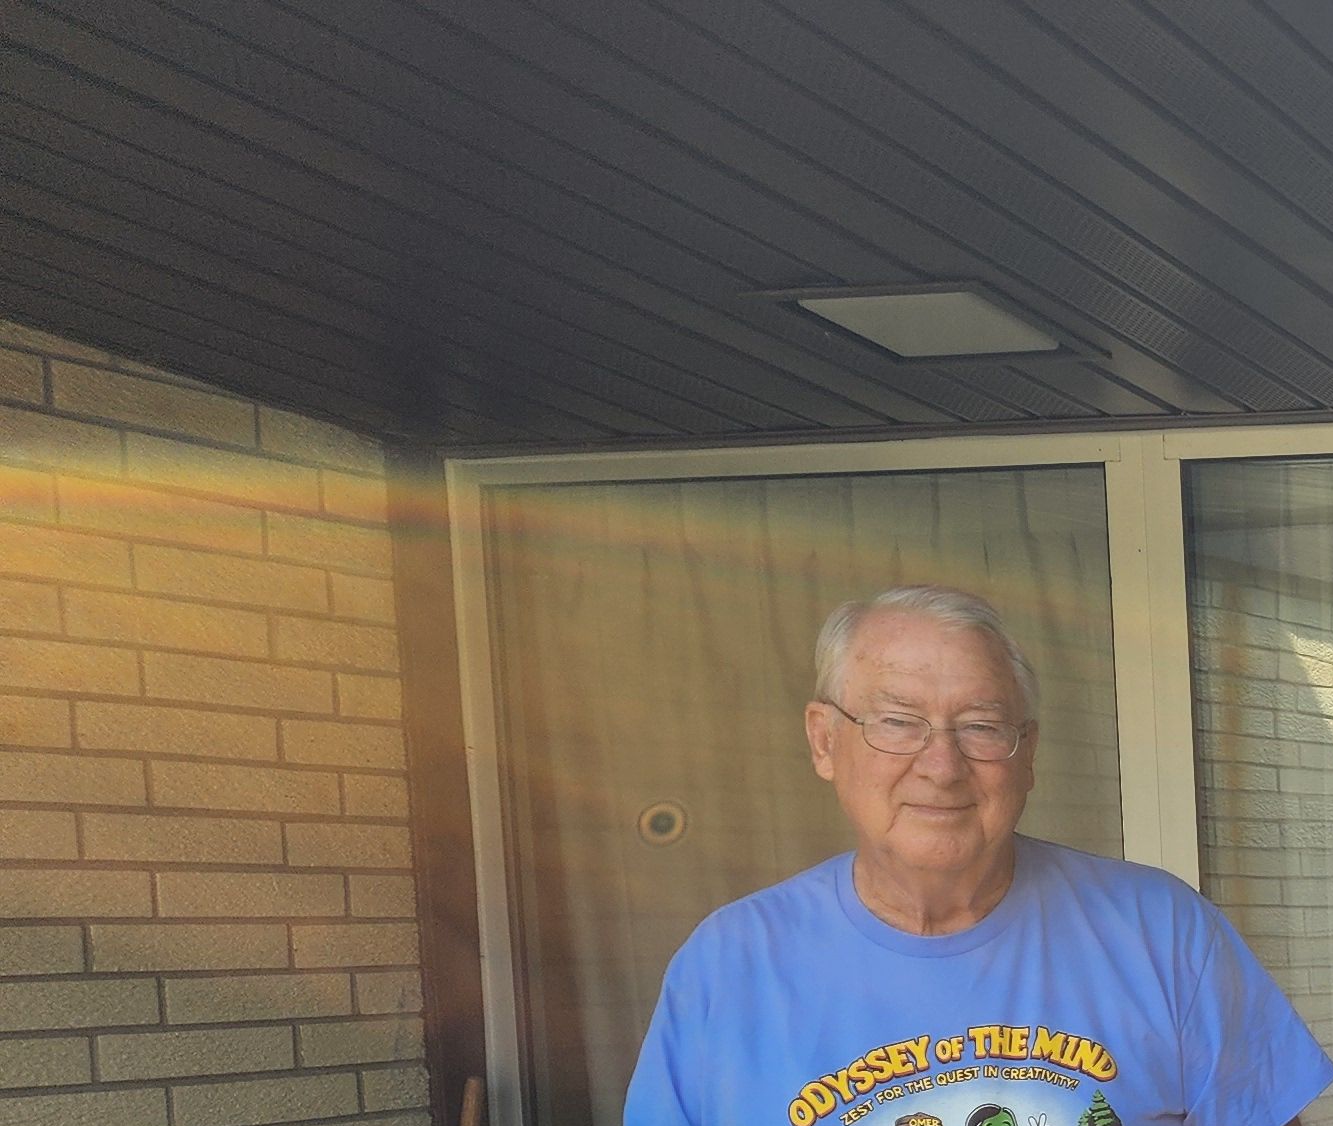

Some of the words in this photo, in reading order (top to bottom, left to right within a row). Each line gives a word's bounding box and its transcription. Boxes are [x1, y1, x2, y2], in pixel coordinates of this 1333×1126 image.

[935, 1036, 965, 1064] OF
[967, 1024, 1030, 1061] THE
[1030, 1025, 1118, 1083] MIND
[839, 1099, 875, 1126] ZEST
[876, 1087, 905, 1104] FOR
[904, 1076, 934, 1095] THE
[936, 1066, 980, 1087] QUEST
[983, 1065, 998, 1078] IN
[1001, 1066, 1080, 1092] CREATIVITY!
